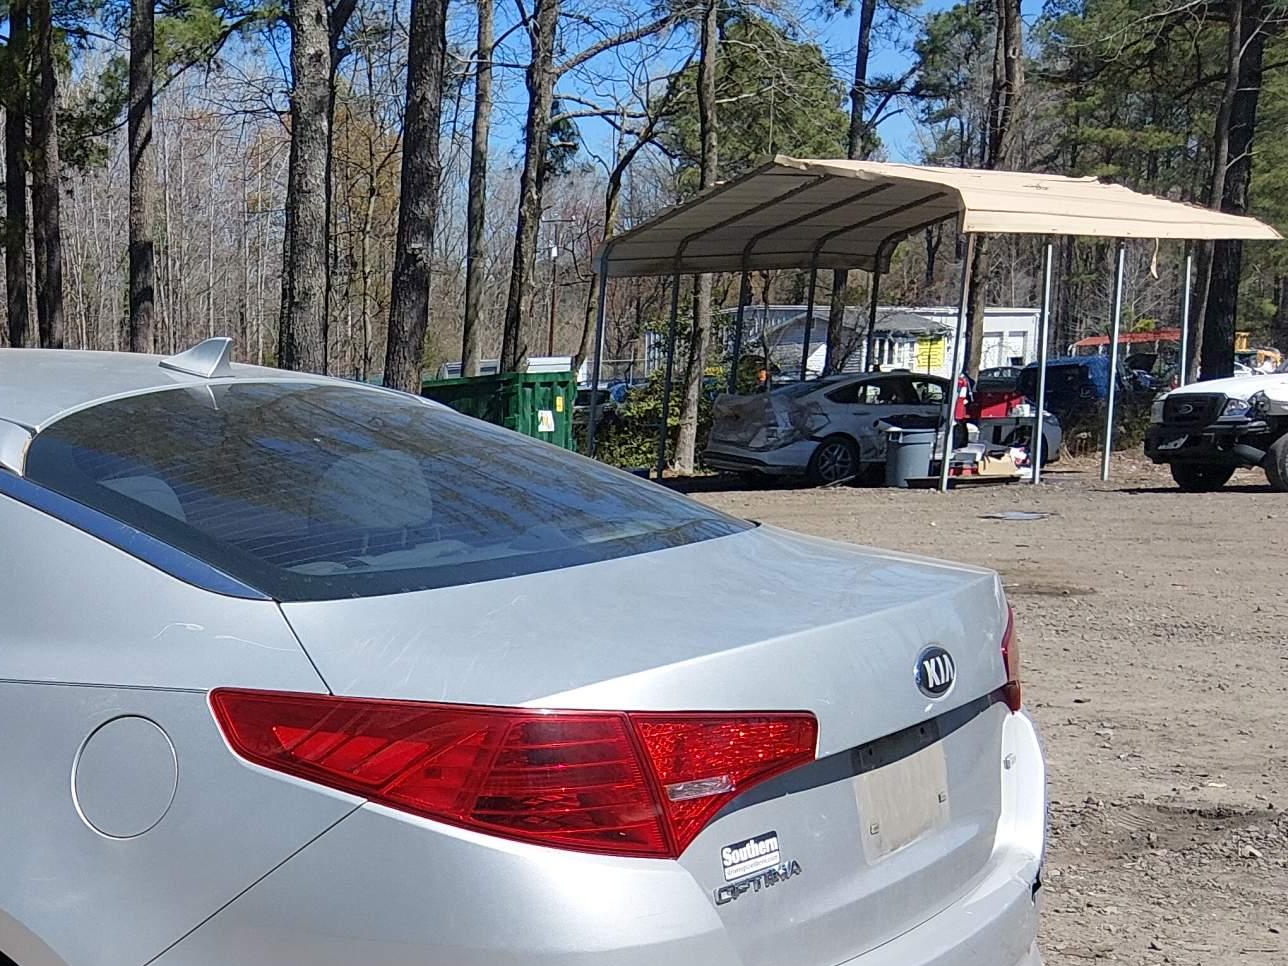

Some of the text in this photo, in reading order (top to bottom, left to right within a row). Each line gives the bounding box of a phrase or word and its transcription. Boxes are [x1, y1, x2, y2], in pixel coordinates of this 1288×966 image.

[922, 654, 954, 689] KIA
[722, 836, 779, 867] Southern
[713, 859, 802, 906] OPTIMA
